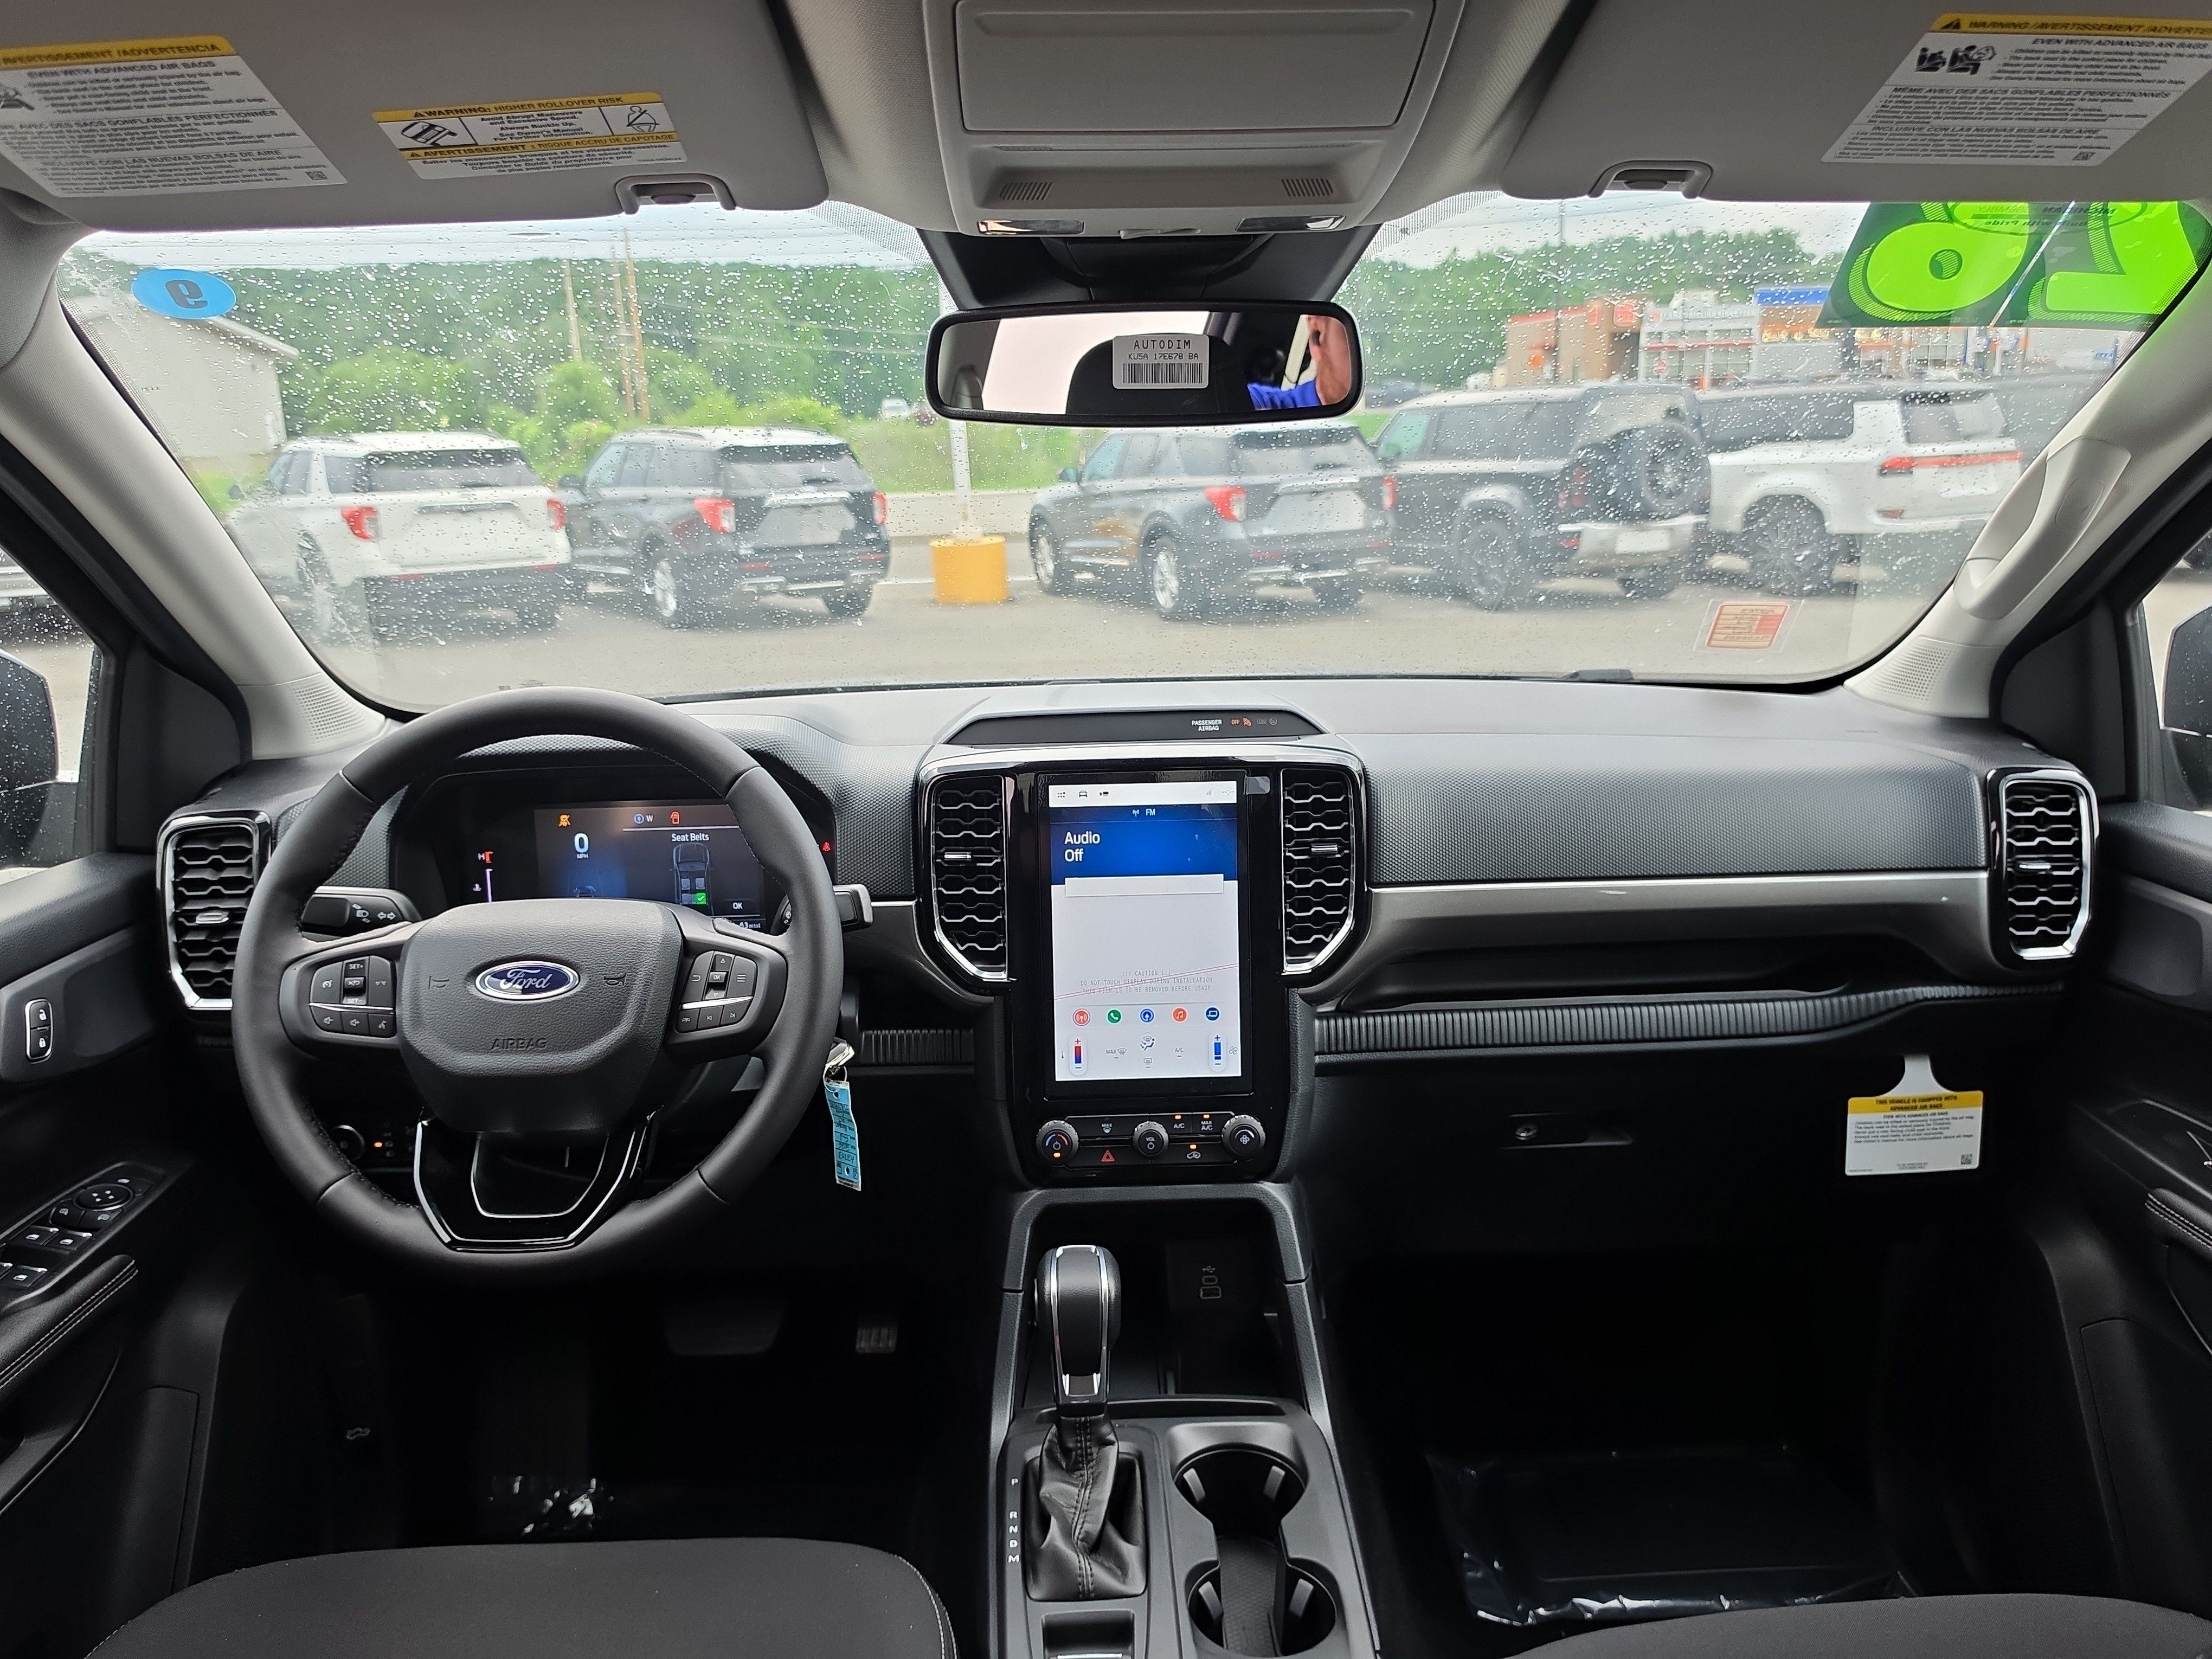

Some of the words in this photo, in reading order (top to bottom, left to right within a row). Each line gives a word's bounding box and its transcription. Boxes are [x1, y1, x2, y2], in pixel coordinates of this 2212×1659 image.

[181, 61, 216, 69] BAGS
[425, 107, 492, 117] WARNING:
[537, 99, 597, 109] ROLLOVER
[424, 144, 526, 157] AVERTISSEMENT
[625, 134, 674, 142] CAPOTAGE
[1134, 339, 1191, 350] AUTODIM
[574, 833, 589, 853] 0
[671, 833, 689, 841] Seat
[690, 833, 710, 841] Belts
[1064, 831, 1100, 845] Audio
[1064, 848, 1084, 862] Off
[499, 968, 552, 990] Ford
[491, 1038, 547, 1051] AIRBAG
[1009, 1511, 1018, 1519] R
[1009, 1525, 1018, 1533] N
[1009, 1539, 1018, 1548] D
[1008, 1554, 1020, 1563] M
